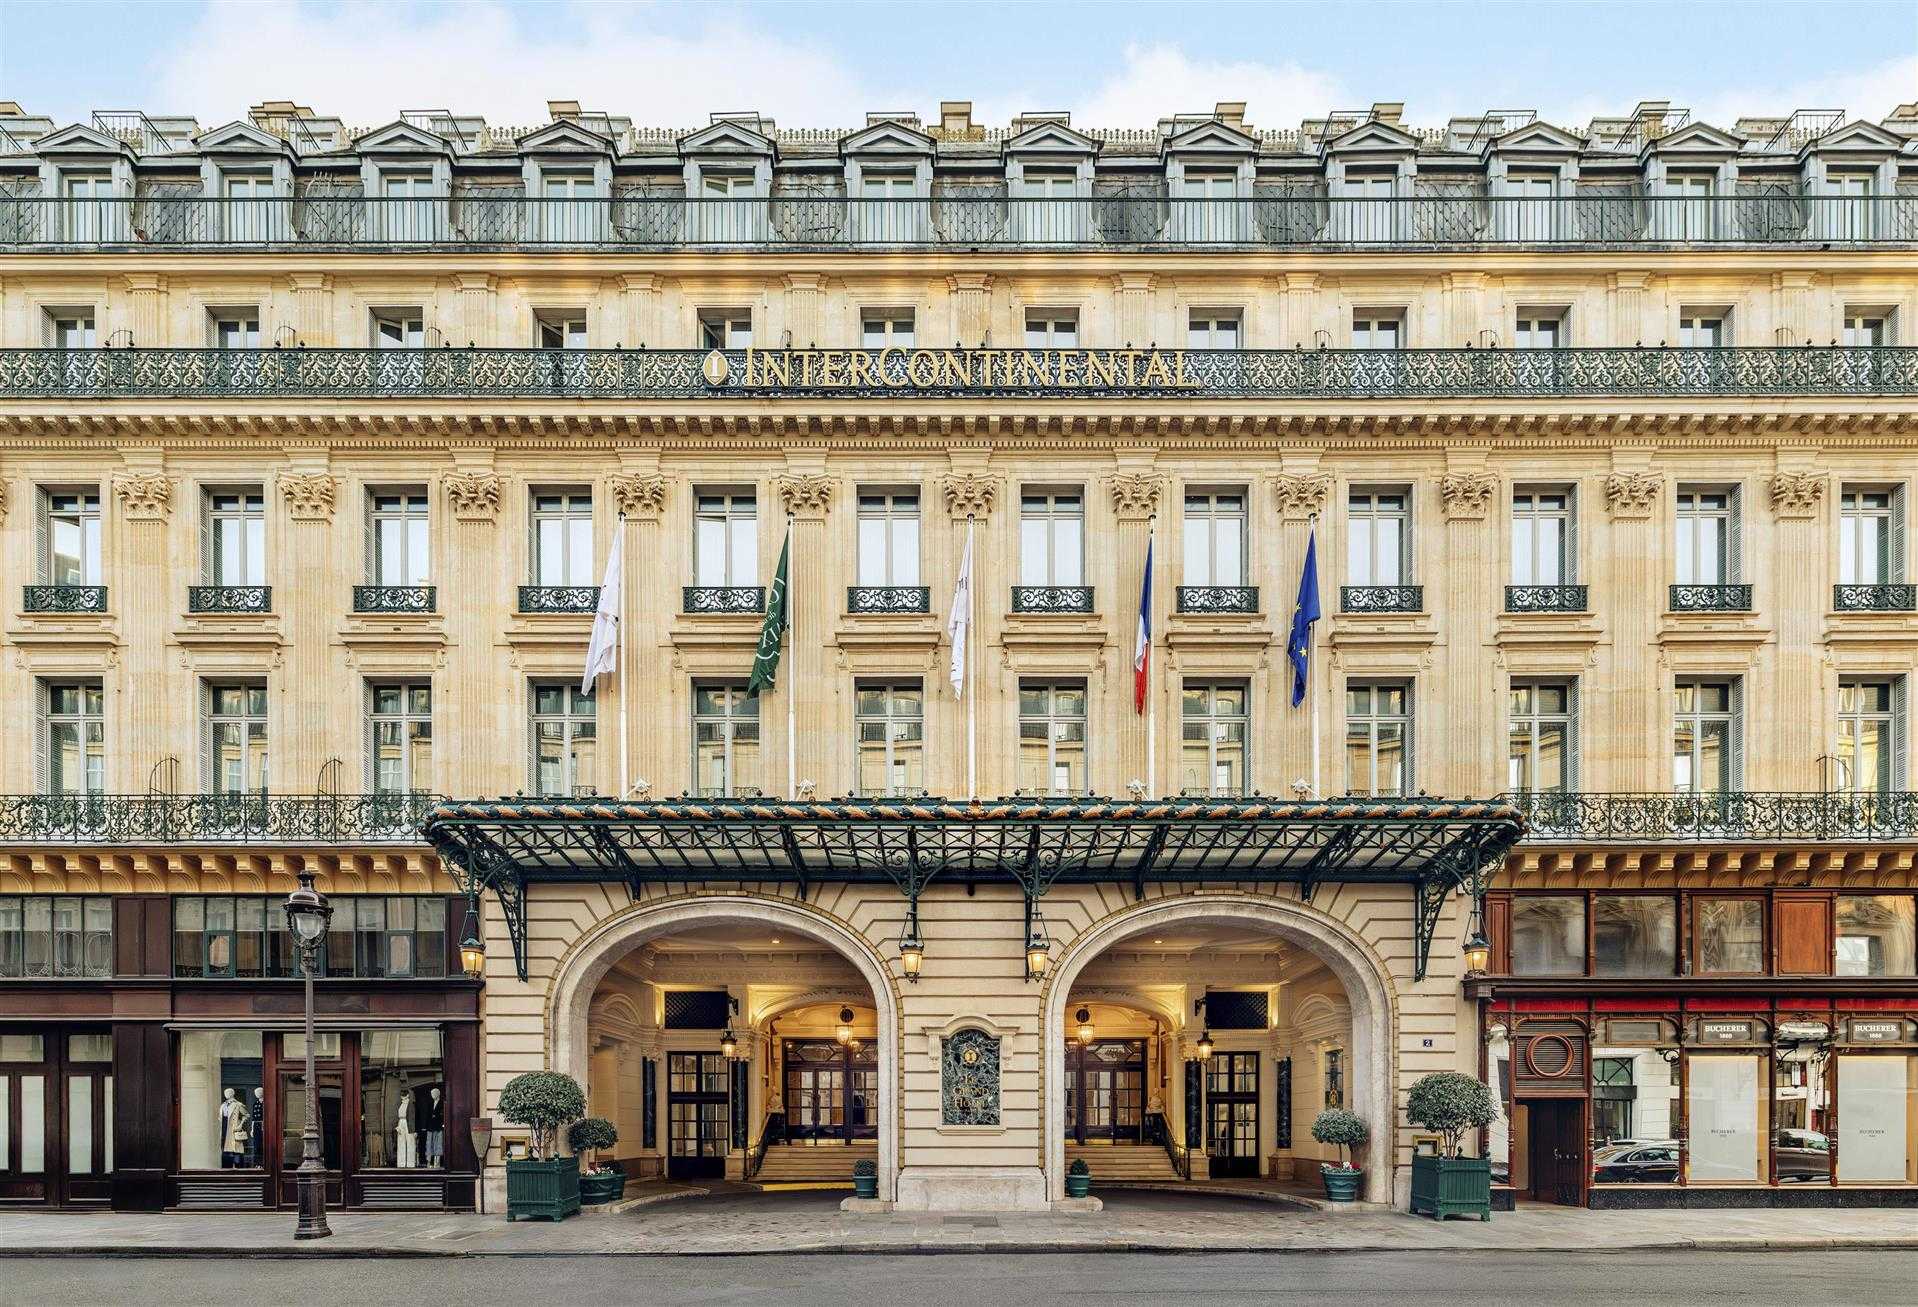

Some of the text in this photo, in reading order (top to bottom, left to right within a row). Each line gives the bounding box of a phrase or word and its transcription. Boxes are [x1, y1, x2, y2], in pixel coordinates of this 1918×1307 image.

[743, 346, 1202, 388] INTERCONTINENTAL
[1705, 1024, 1747, 1032] BUCHERER
[1855, 1024, 1897, 1032] BUCHERER
[1424, 1039, 1431, 1047] 2
